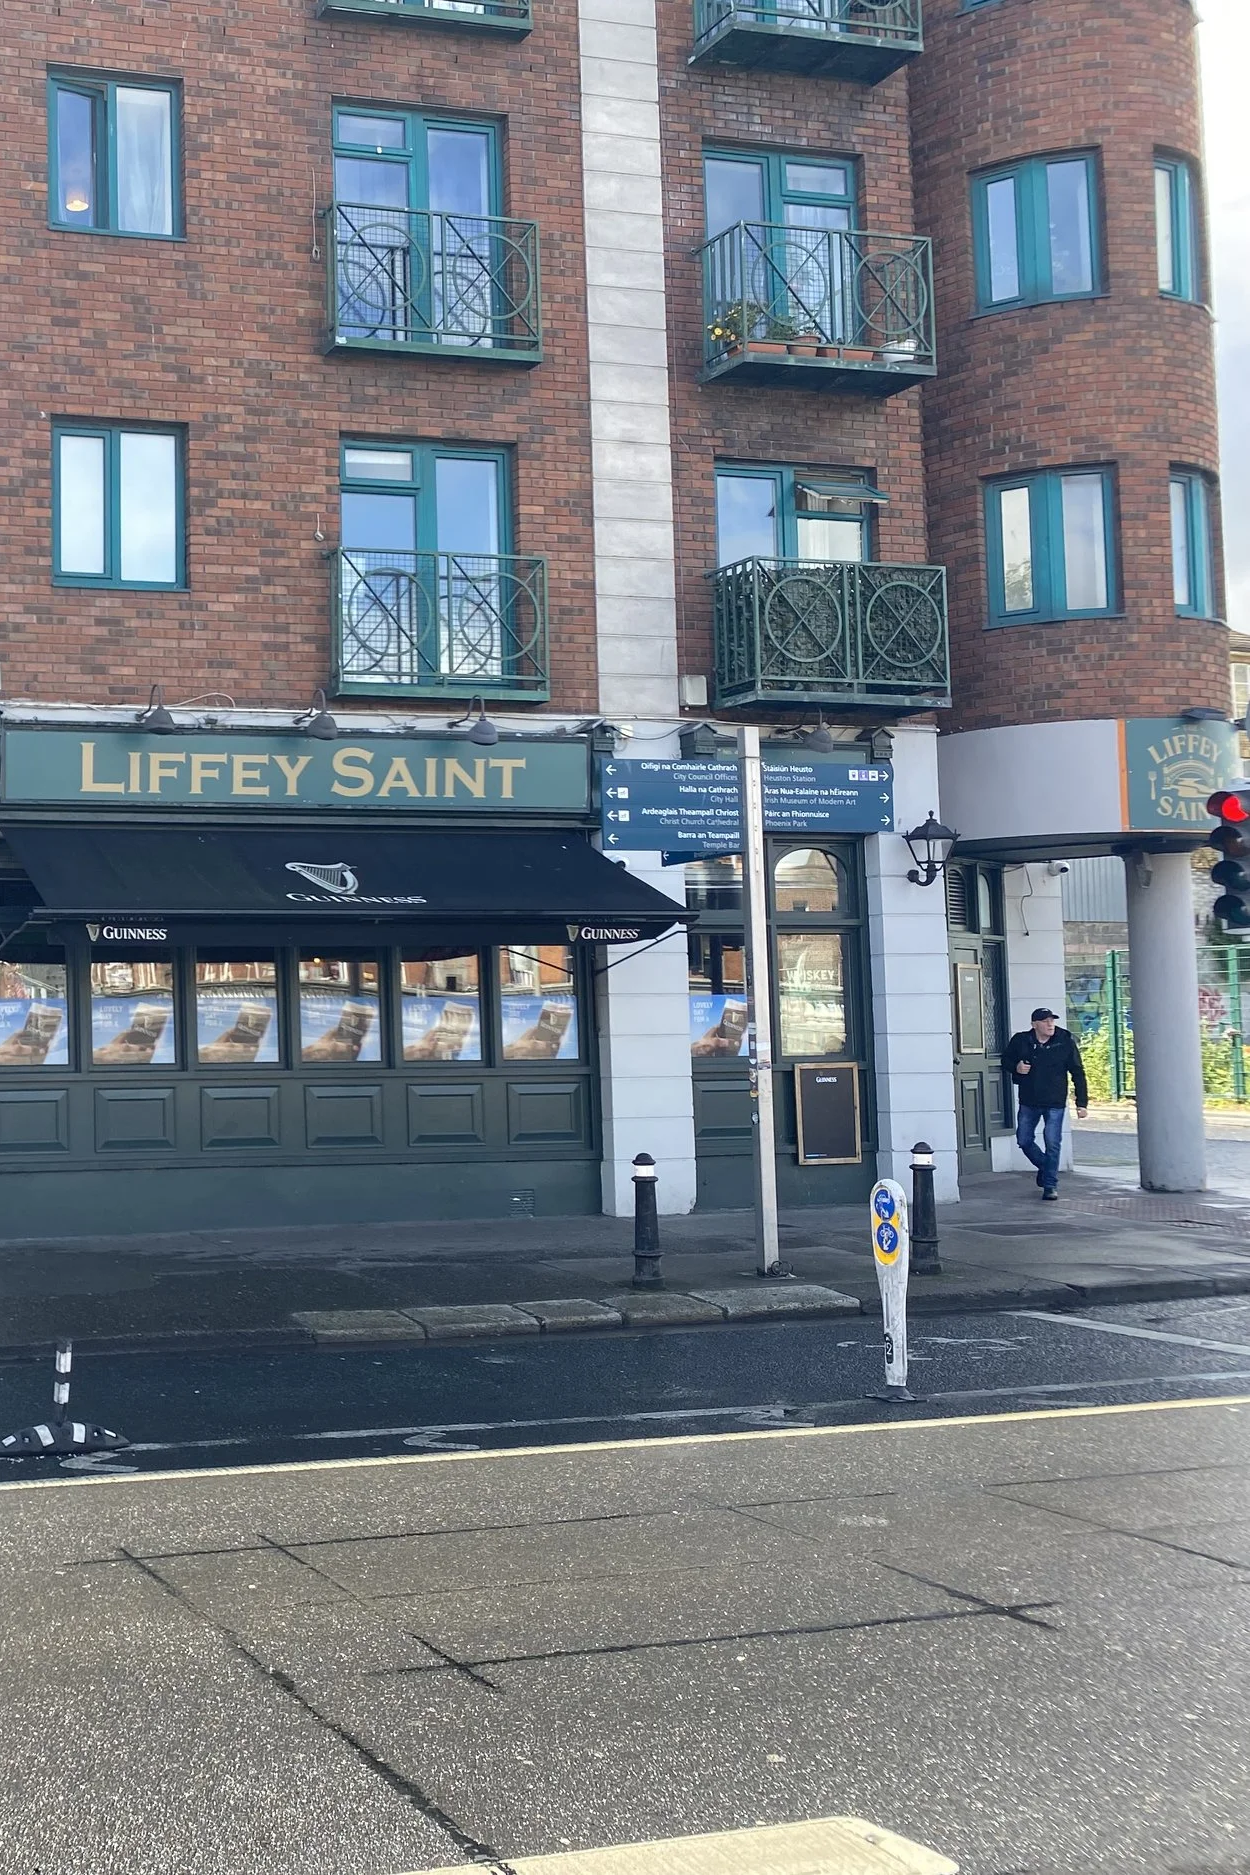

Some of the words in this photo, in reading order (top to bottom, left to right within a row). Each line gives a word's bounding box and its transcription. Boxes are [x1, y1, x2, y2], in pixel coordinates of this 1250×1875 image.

[1147, 734, 1223, 764] LIFFEY
[80, 742, 312, 797] LIFFEY
[331, 747, 526, 799] SAINT
[672, 763, 706, 771] Comhairle
[673, 773, 687, 781] City
[714, 773, 737, 781] Offices
[764, 774, 790, 782] Heuston
[679, 785, 697, 793] Halla
[708, 786, 738, 794] Cathrach
[711, 795, 724, 804] City
[641, 808, 678, 816] Ardeaglais
[1156, 795, 1212, 821] SAIN
[791, 810, 829, 818] Fhionnuisce
[706, 818, 739, 826] Cathedral
[765, 819, 791, 827] Phoenix
[702, 841, 727, 849] Temple
[286, 891, 427, 904] GUINNESS
[103, 925, 168, 941] GUINNESS
[581, 925, 640, 940] GUINNESS
[693, 1001, 713, 1009] LOVELY
